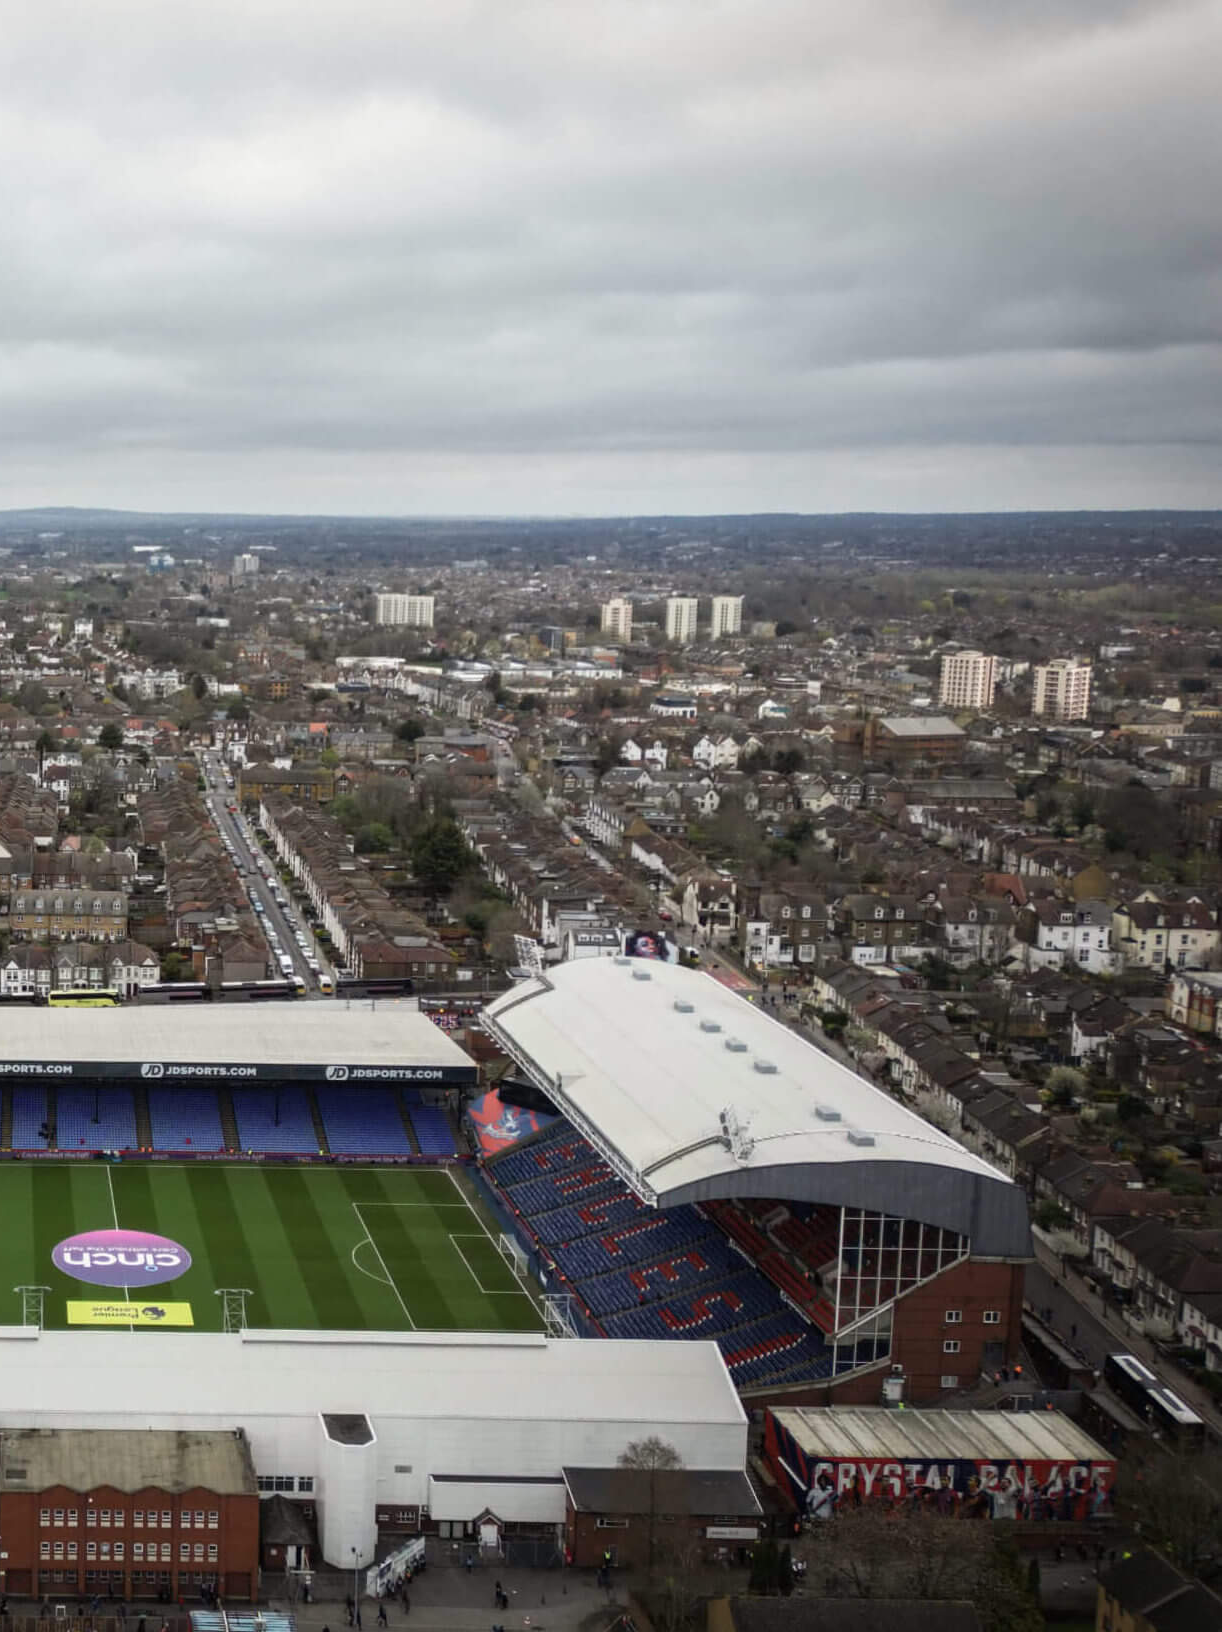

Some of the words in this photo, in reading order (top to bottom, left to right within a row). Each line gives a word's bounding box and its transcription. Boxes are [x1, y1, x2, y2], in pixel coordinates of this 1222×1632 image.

[141, 1063, 164, 1078] JD
[165, 1066, 257, 1076] JDSPORTS.COM
[326, 1066, 349, 1081] JD
[351, 1069, 443, 1079] JDSPORTS.COM
[63, 1252, 181, 1271] cinch
